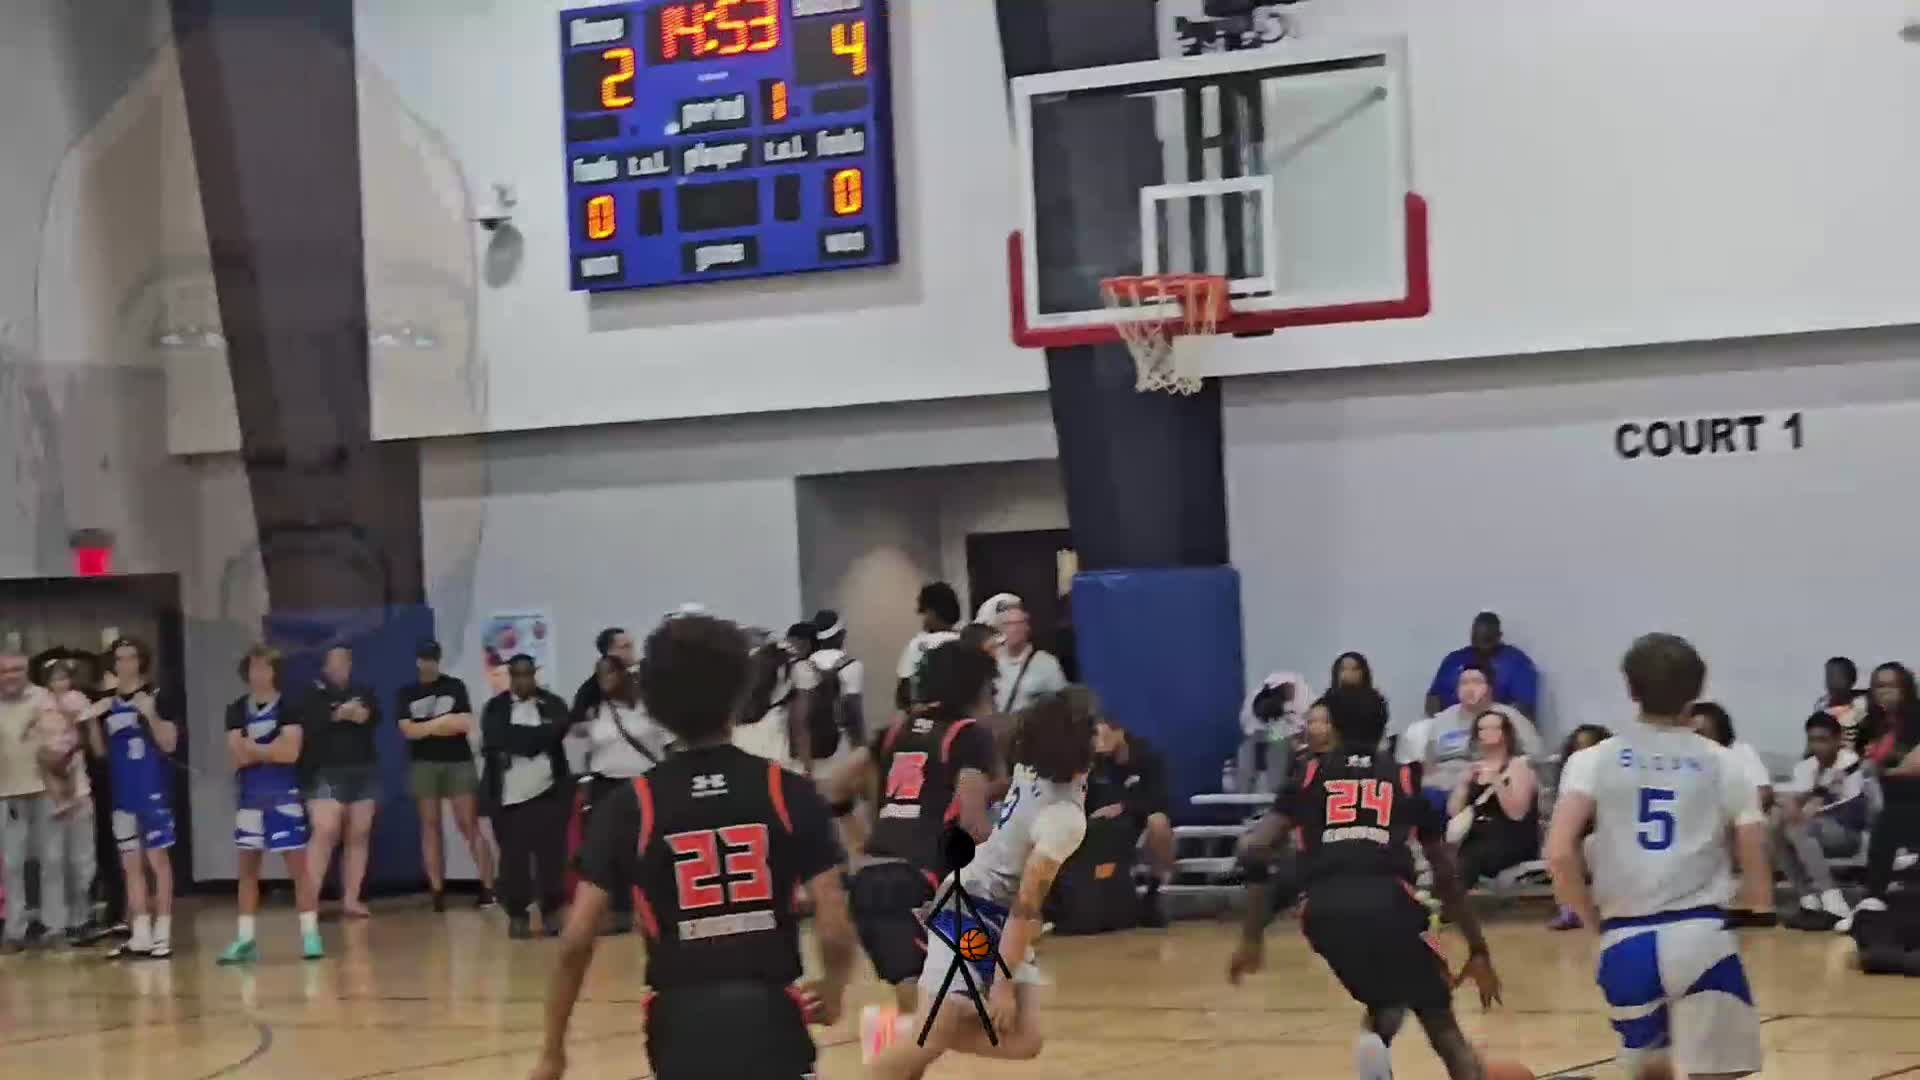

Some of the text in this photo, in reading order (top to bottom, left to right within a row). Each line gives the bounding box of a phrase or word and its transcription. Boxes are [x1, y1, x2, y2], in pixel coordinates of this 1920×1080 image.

[661, 0, 780, 58] 14:53
[831, 21, 867, 75] 4
[602, 48, 635, 107] 2
[771, 81, 787, 120] 1
[588, 195, 615, 239] 0
[833, 168, 863, 215] 0
[1615, 412, 1804, 458] COURT 1
[1323, 779, 1393, 827] 24
[1637, 787, 1676, 850] 5
[663, 823, 773, 910] 23
